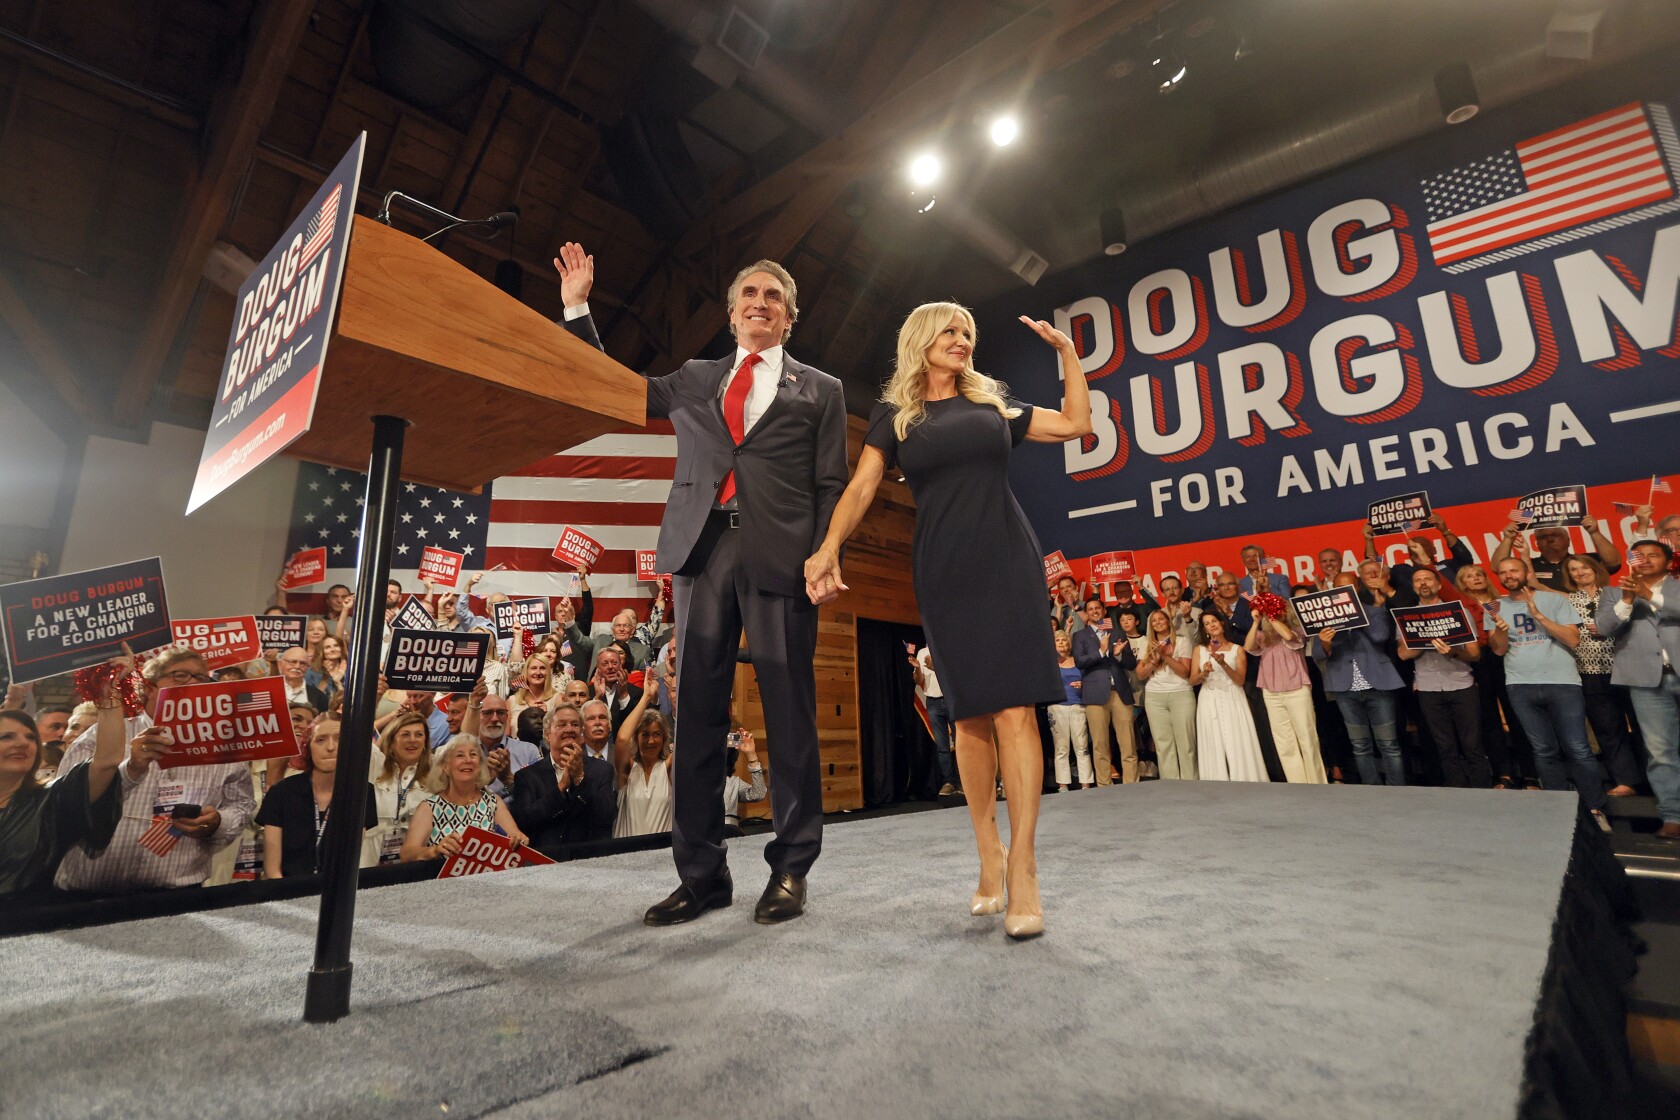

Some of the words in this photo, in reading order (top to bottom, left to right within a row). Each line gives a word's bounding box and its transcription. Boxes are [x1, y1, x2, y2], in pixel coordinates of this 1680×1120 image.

[235, 233, 303, 344] DOUG
[1054, 198, 1408, 384] DOUG
[222, 248, 331, 402] BURGUM
[228, 390, 248, 423] FOR
[247, 348, 293, 406] AMERICA
[1151, 466, 1246, 517] FOR
[1277, 402, 1596, 497] AMERICA
[1371, 500, 1404, 515] DOUG
[1520, 493, 1554, 510] DOUG
[1525, 502, 1580, 516] RGUM
[1371, 507, 1426, 525] BURGUM
[1539, 515, 1569, 523] AMERICA
[565, 531, 592, 550] DOUG
[561, 540, 597, 565] BURGUM
[640, 553, 656, 562] DO
[1046, 561, 1065, 575] GUM
[31, 590, 80, 609] DOUG
[87, 576, 144, 599] BURGUM
[35, 614, 46, 627] A
[54, 605, 90, 623] NEW
[98, 592, 147, 614] LEADER
[1296, 596, 1332, 612] DOUG
[1300, 602, 1357, 623] BURGUM
[26, 625, 60, 641] FOR
[69, 621, 79, 633] A
[86, 602, 155, 629] CHANGING
[408, 602, 433, 628] DOUG
[1324, 617, 1350, 626] AMERICA
[1421, 610, 1453, 619] BURGUM
[1426, 617, 1455, 627] LEADER
[62, 620, 135, 647] ECONOMY
[175, 624, 210, 638] UG
[257, 620, 283, 631] OUG
[1418, 630, 1449, 638] ECONOMY
[1424, 621, 1461, 632] CHANGING
[176, 631, 248, 650] RGUM
[262, 631, 300, 642] RGUM
[398, 637, 455, 656] DOUG
[394, 655, 478, 673] BURGUM
[407, 674, 425, 682] FOR
[426, 675, 461, 683] AMERICA
[161, 693, 233, 722] DOUG
[159, 713, 280, 746] BURGUM
[186, 744, 208, 756] FOR
[213, 739, 264, 754] AMERICA
[461, 837, 522, 870] DOUG
